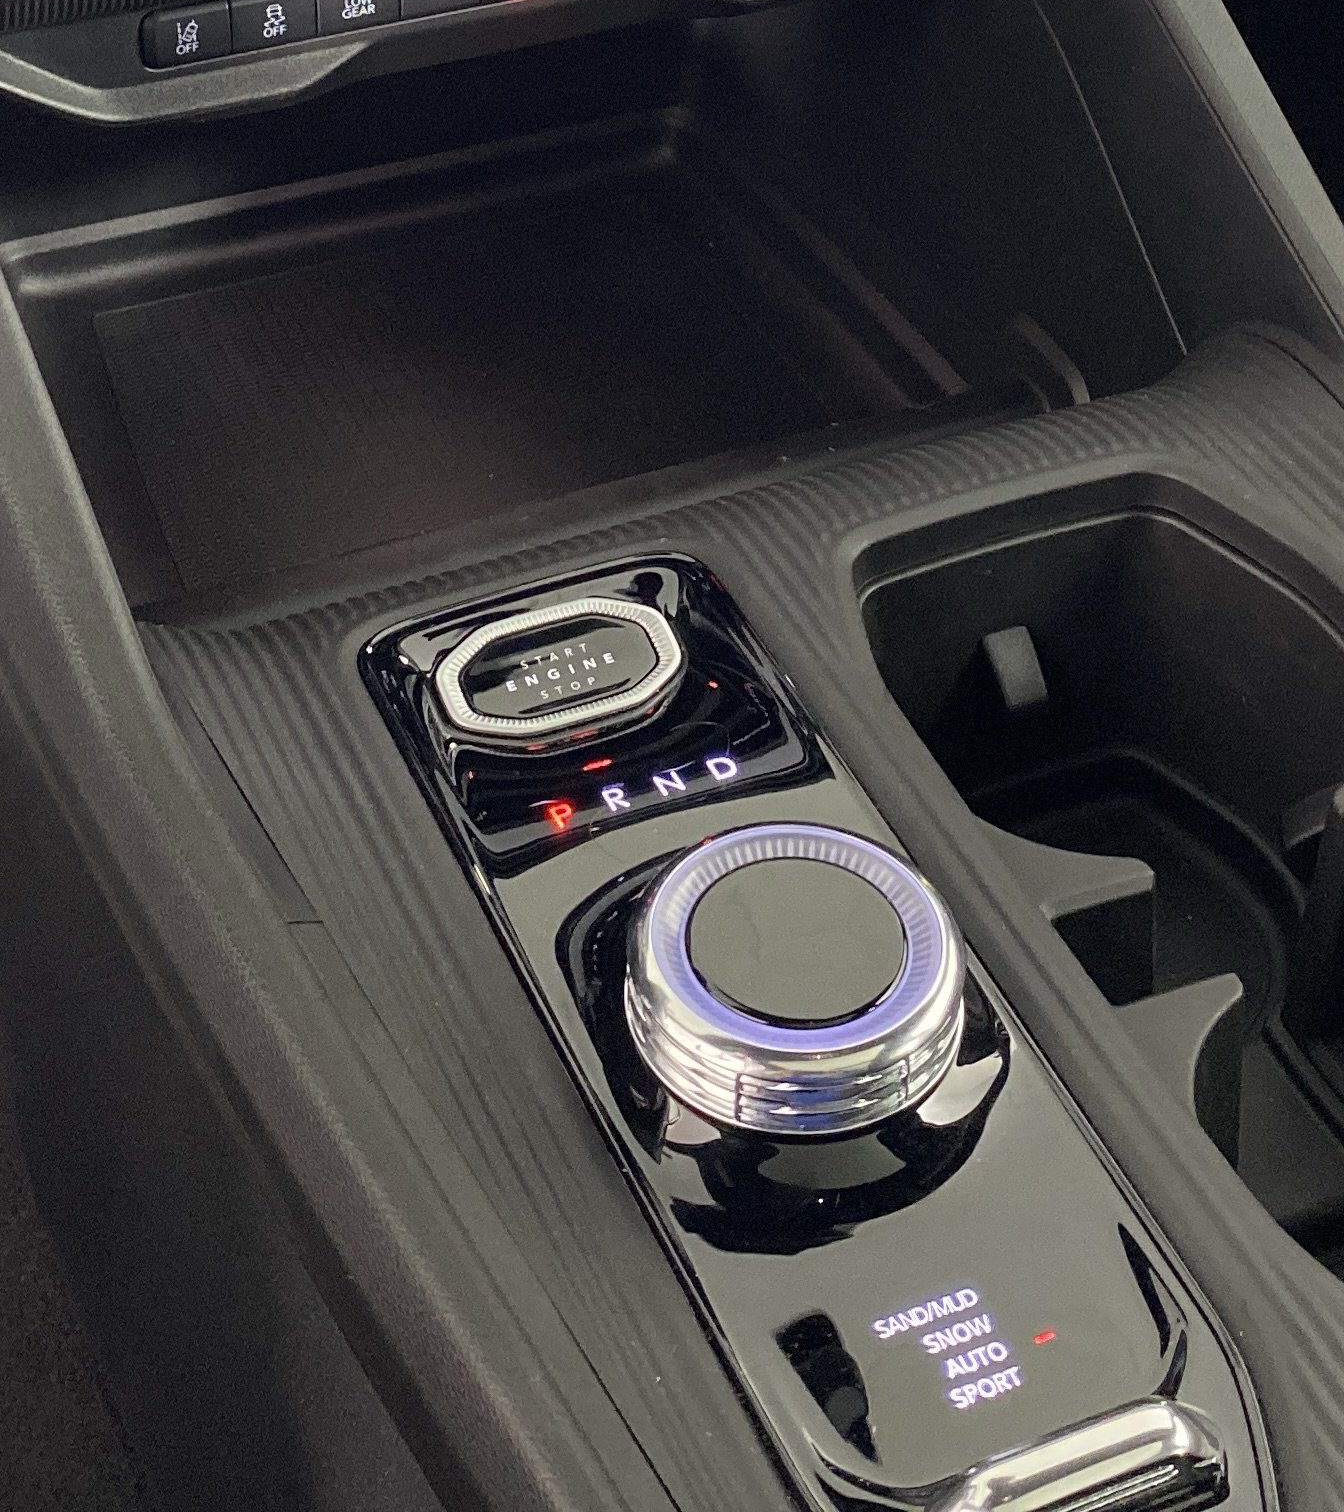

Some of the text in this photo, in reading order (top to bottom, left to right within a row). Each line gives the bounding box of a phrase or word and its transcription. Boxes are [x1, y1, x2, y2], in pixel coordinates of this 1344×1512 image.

[341, 3, 376, 19] GEAR
[175, 41, 199, 55] OFF
[262, 24, 287, 39] OFF
[505, 651, 617, 693] ENGINE
[521, 642, 588, 670] START
[540, 676, 597, 700] STOP
[547, 757, 738, 832] P R N D
[873, 1288, 979, 1339] SAND/MUD
[922, 1314, 992, 1354] SNOW
[945, 1341, 1009, 1379] AUTO
[949, 1367, 1022, 1409] SPORT
